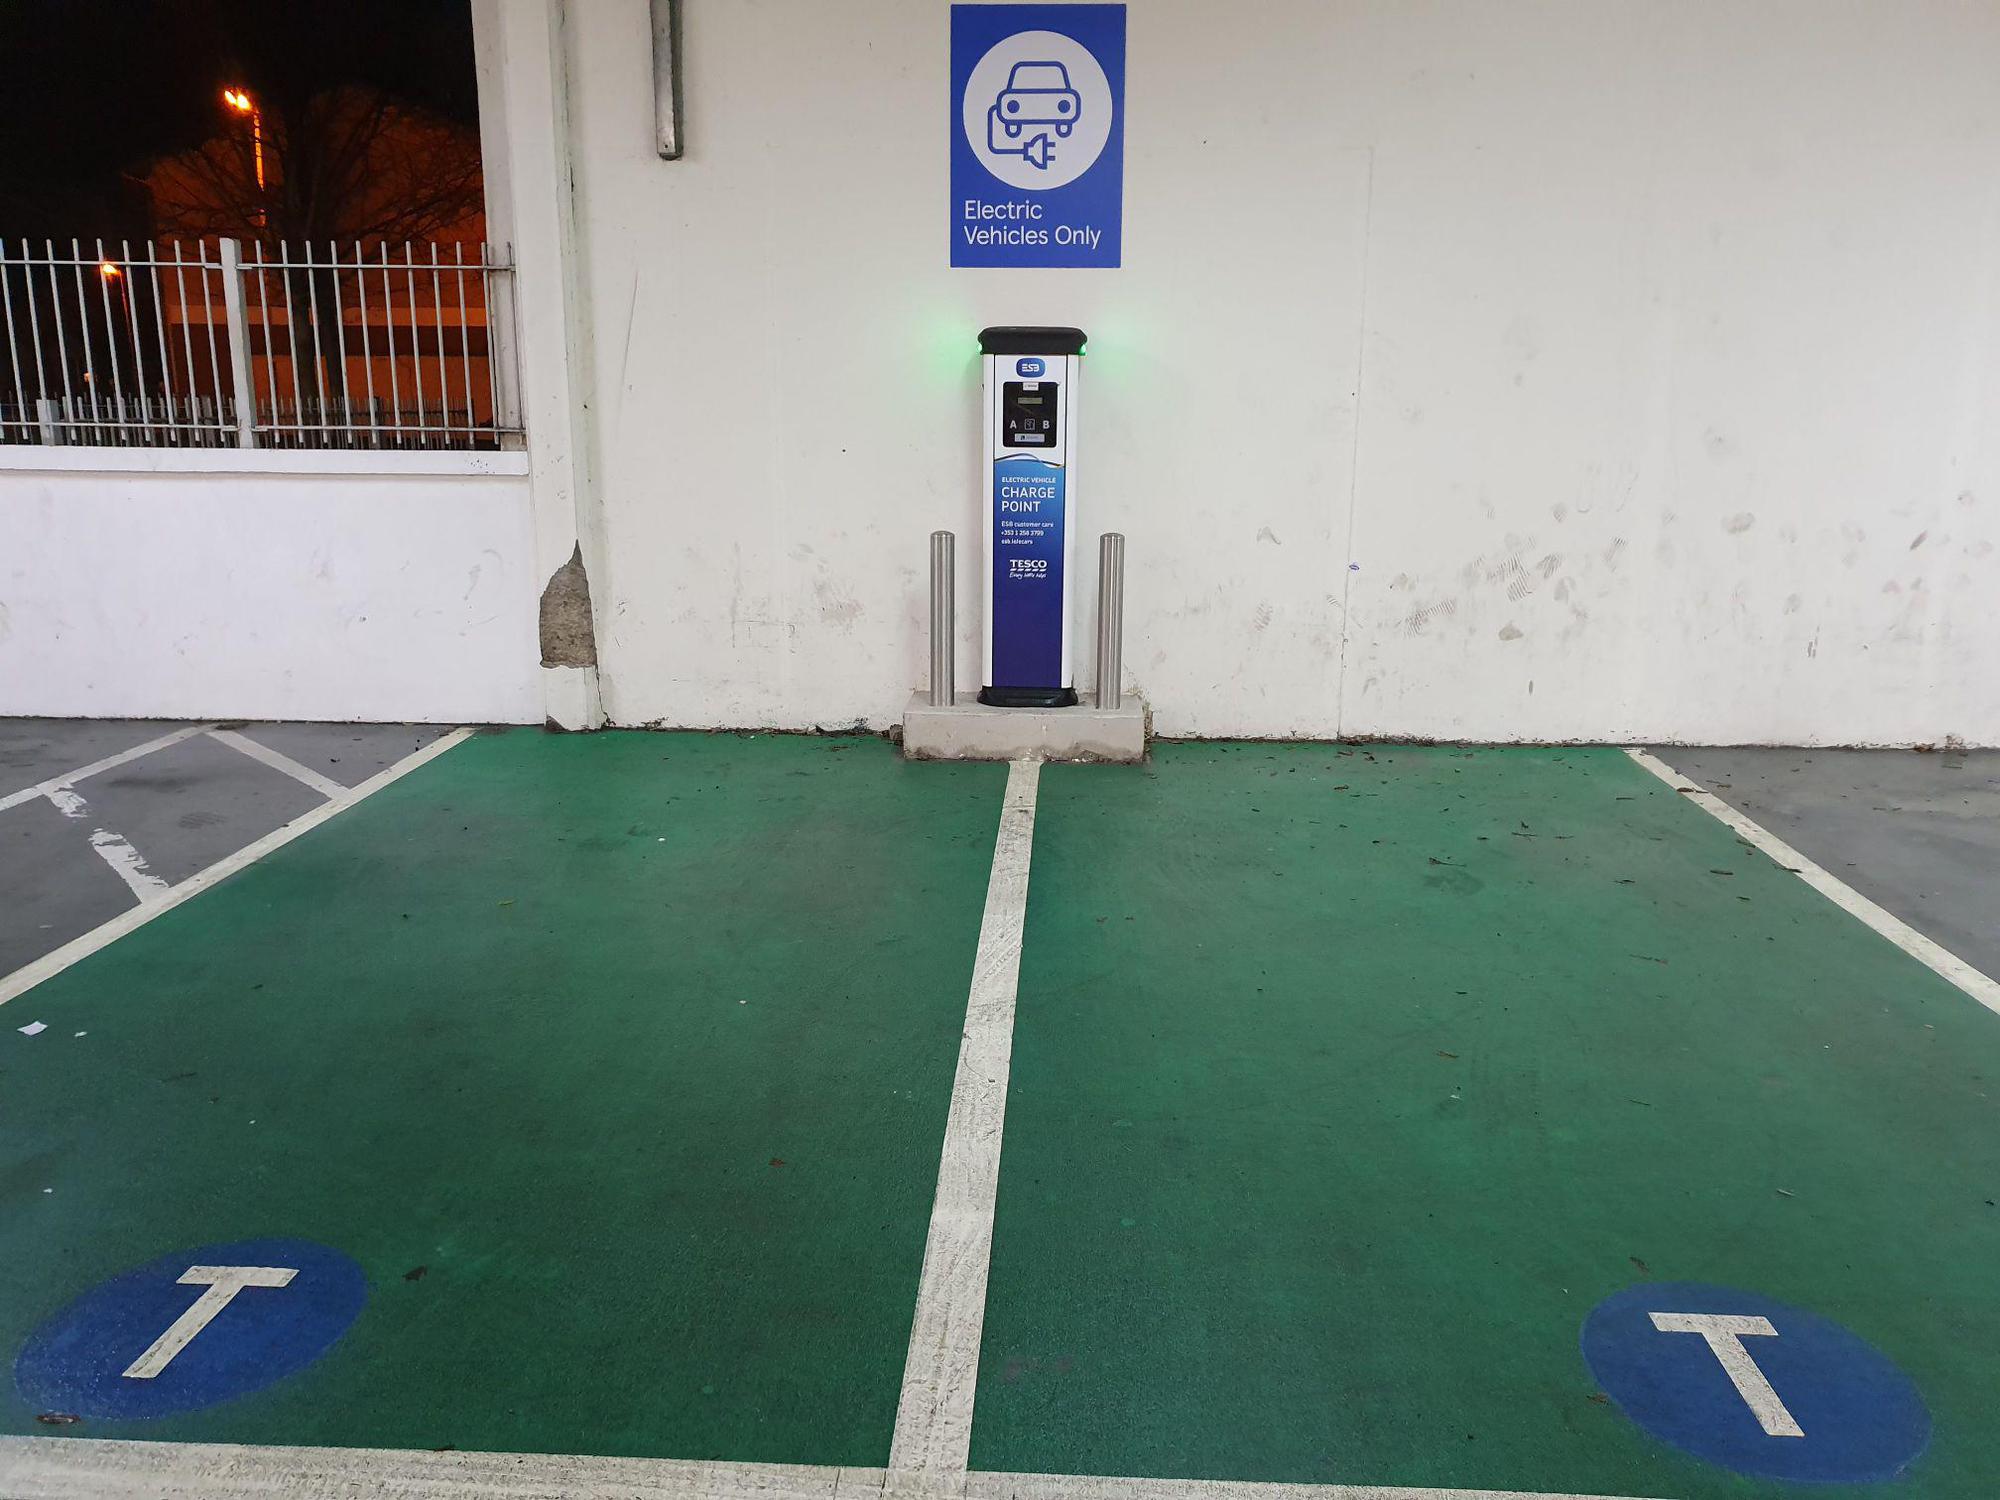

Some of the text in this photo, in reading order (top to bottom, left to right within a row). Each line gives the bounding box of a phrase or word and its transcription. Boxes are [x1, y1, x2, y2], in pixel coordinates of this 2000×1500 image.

[964, 200, 1043, 220] Electric
[963, 225, 1101, 250] Vehicles Only
[1009, 420, 1050, 430] A B
[1031, 476, 1057, 484] VEHICLE
[1001, 486, 1056, 499] CHARGE
[1001, 500, 1041, 513] POINT
[1009, 559, 1048, 569] TESCO
[176, 1265, 300, 1378] T
[1648, 1312, 1805, 1437] T
